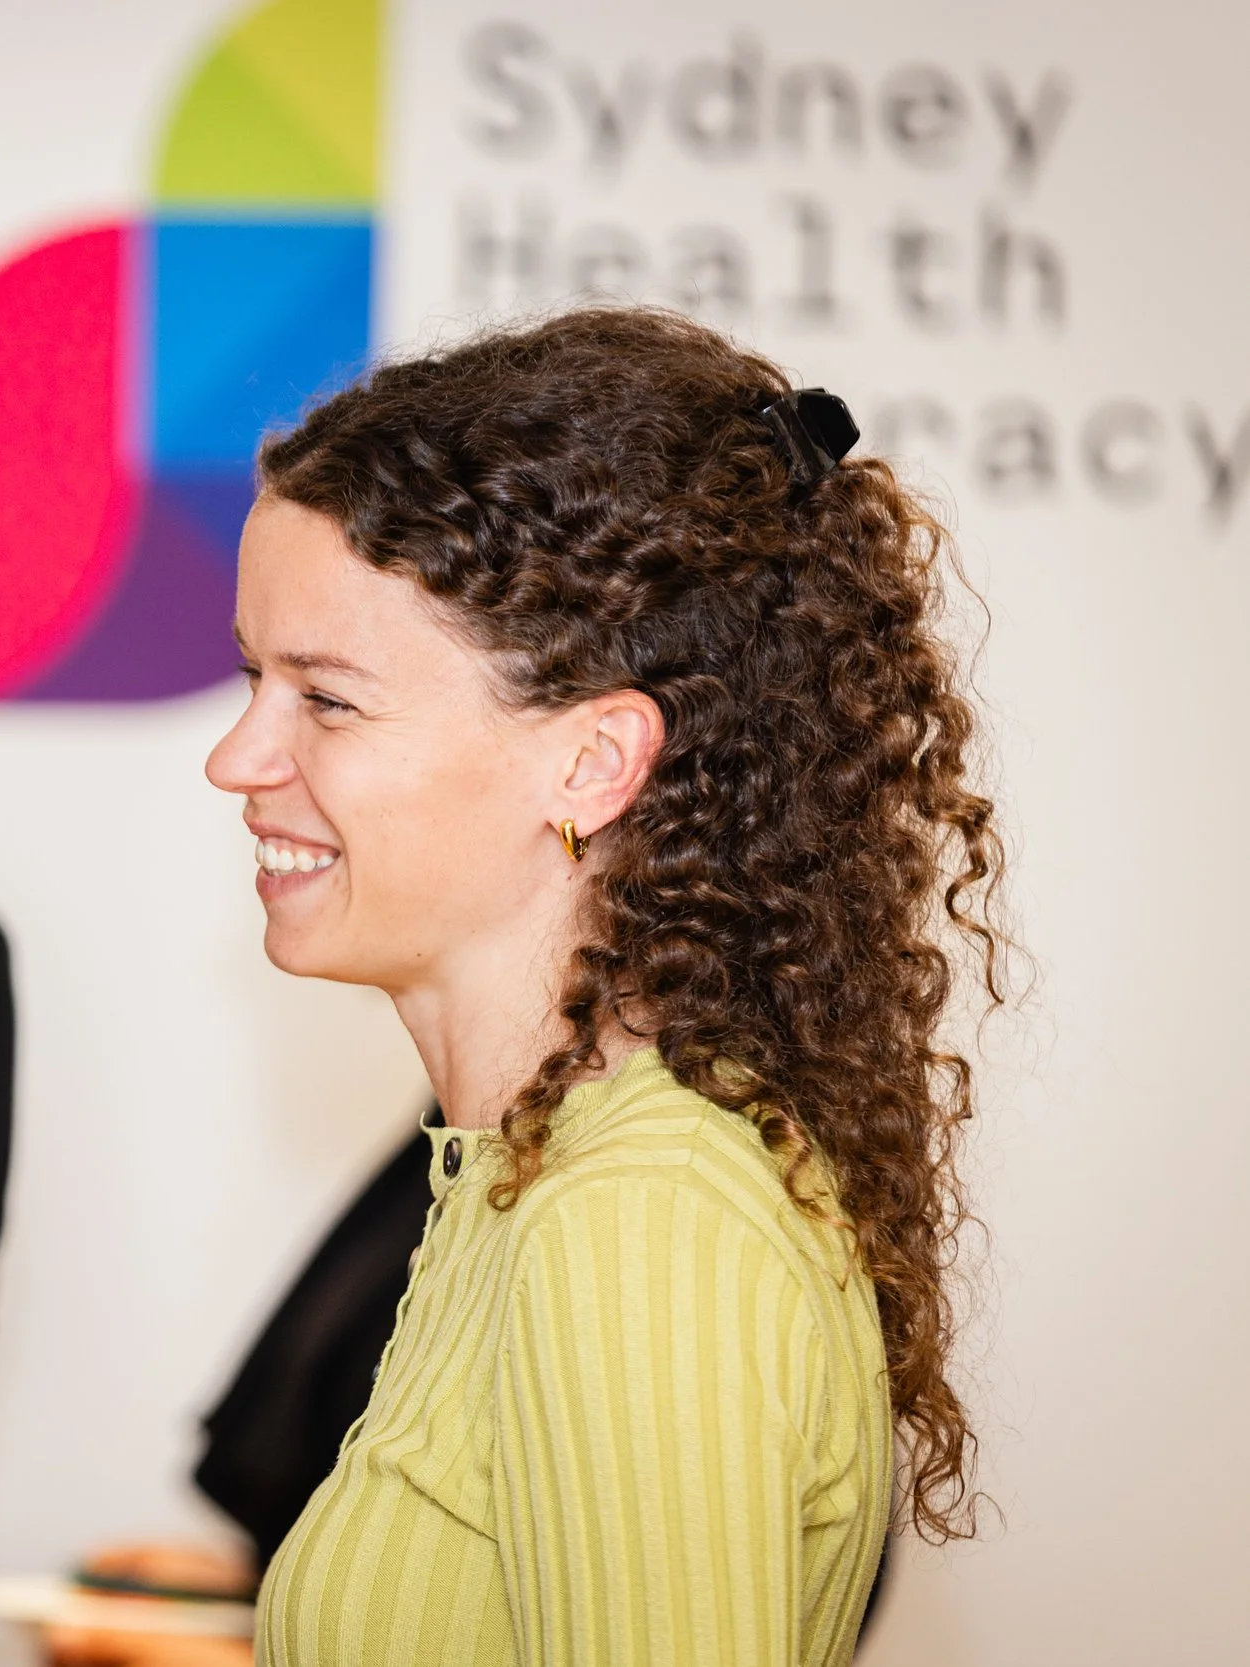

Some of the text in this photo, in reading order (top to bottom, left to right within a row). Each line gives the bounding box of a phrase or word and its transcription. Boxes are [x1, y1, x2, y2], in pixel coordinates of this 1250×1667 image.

[460, 20, 1073, 190] Sydney
[454, 197, 1069, 333] Health
[874, 396, 1250, 532] racy
